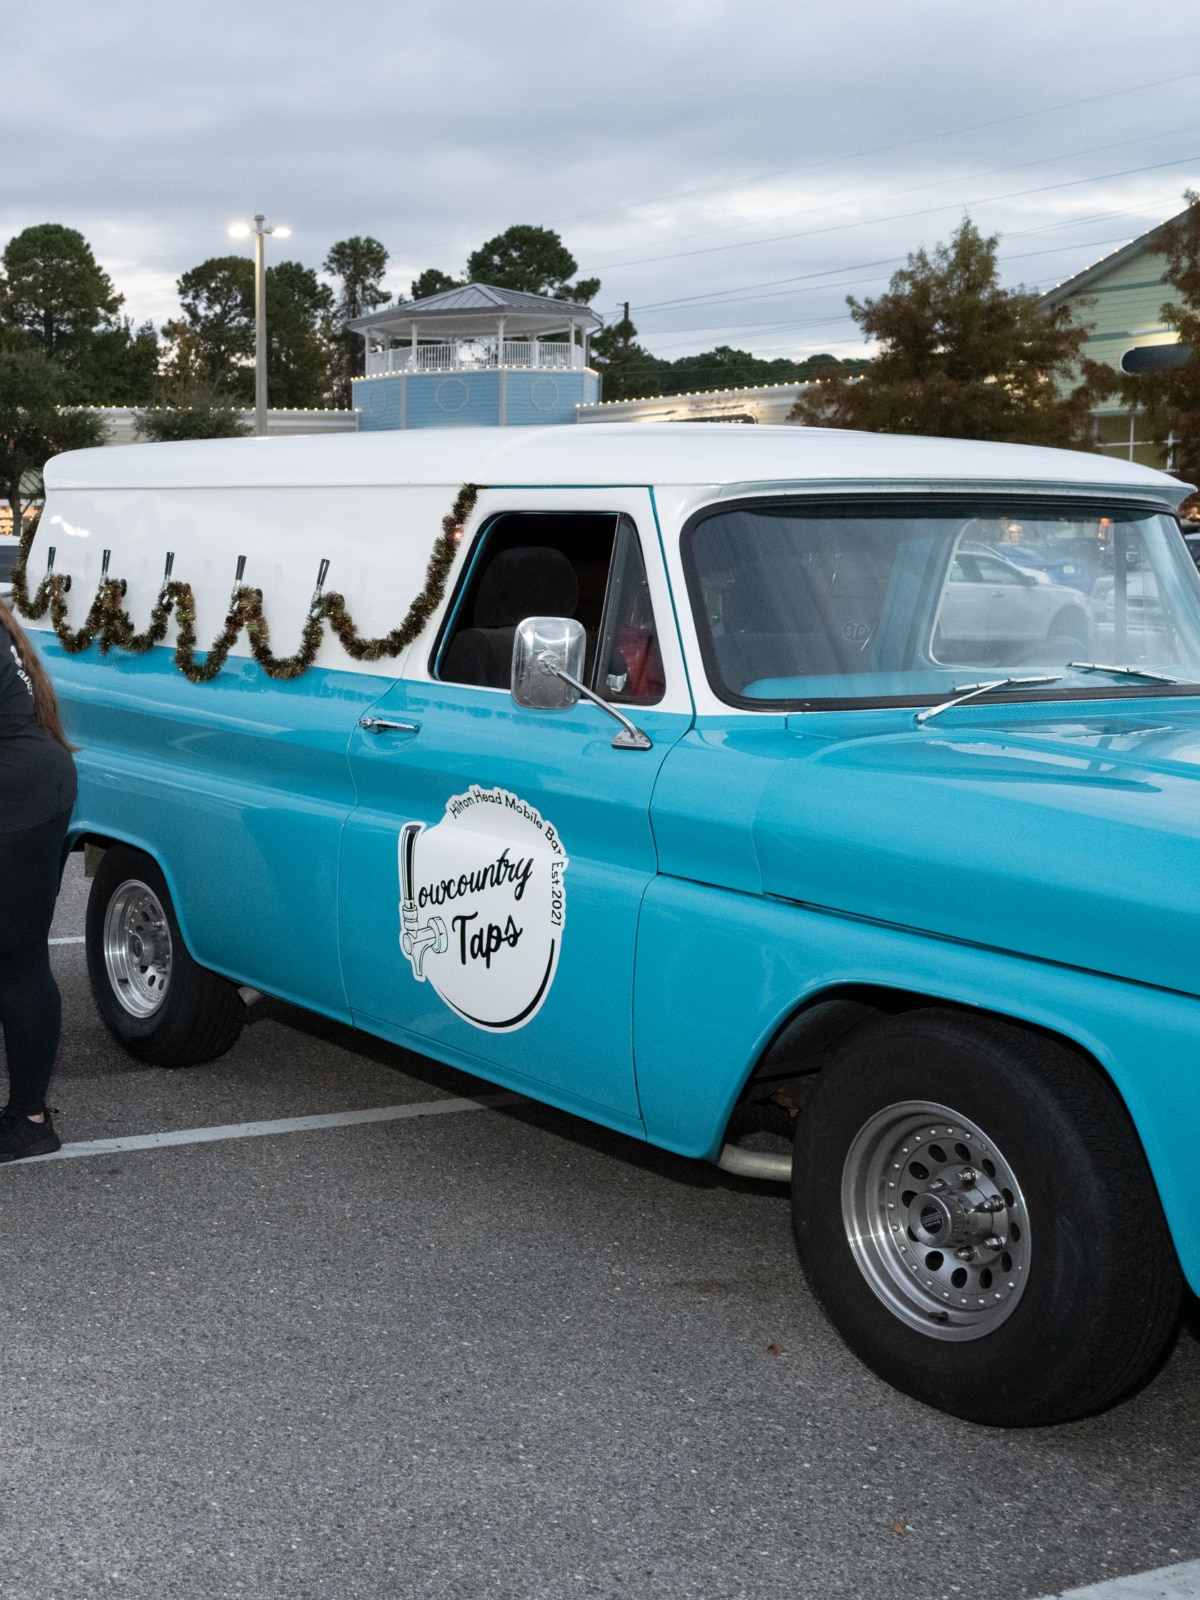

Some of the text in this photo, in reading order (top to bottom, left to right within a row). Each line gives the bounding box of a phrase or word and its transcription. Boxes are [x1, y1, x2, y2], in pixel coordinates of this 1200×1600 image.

[845, 622, 866, 639] STP
[449, 789, 562, 856] Hilton Head Mobile Bar
[451, 911, 524, 970] Taps
